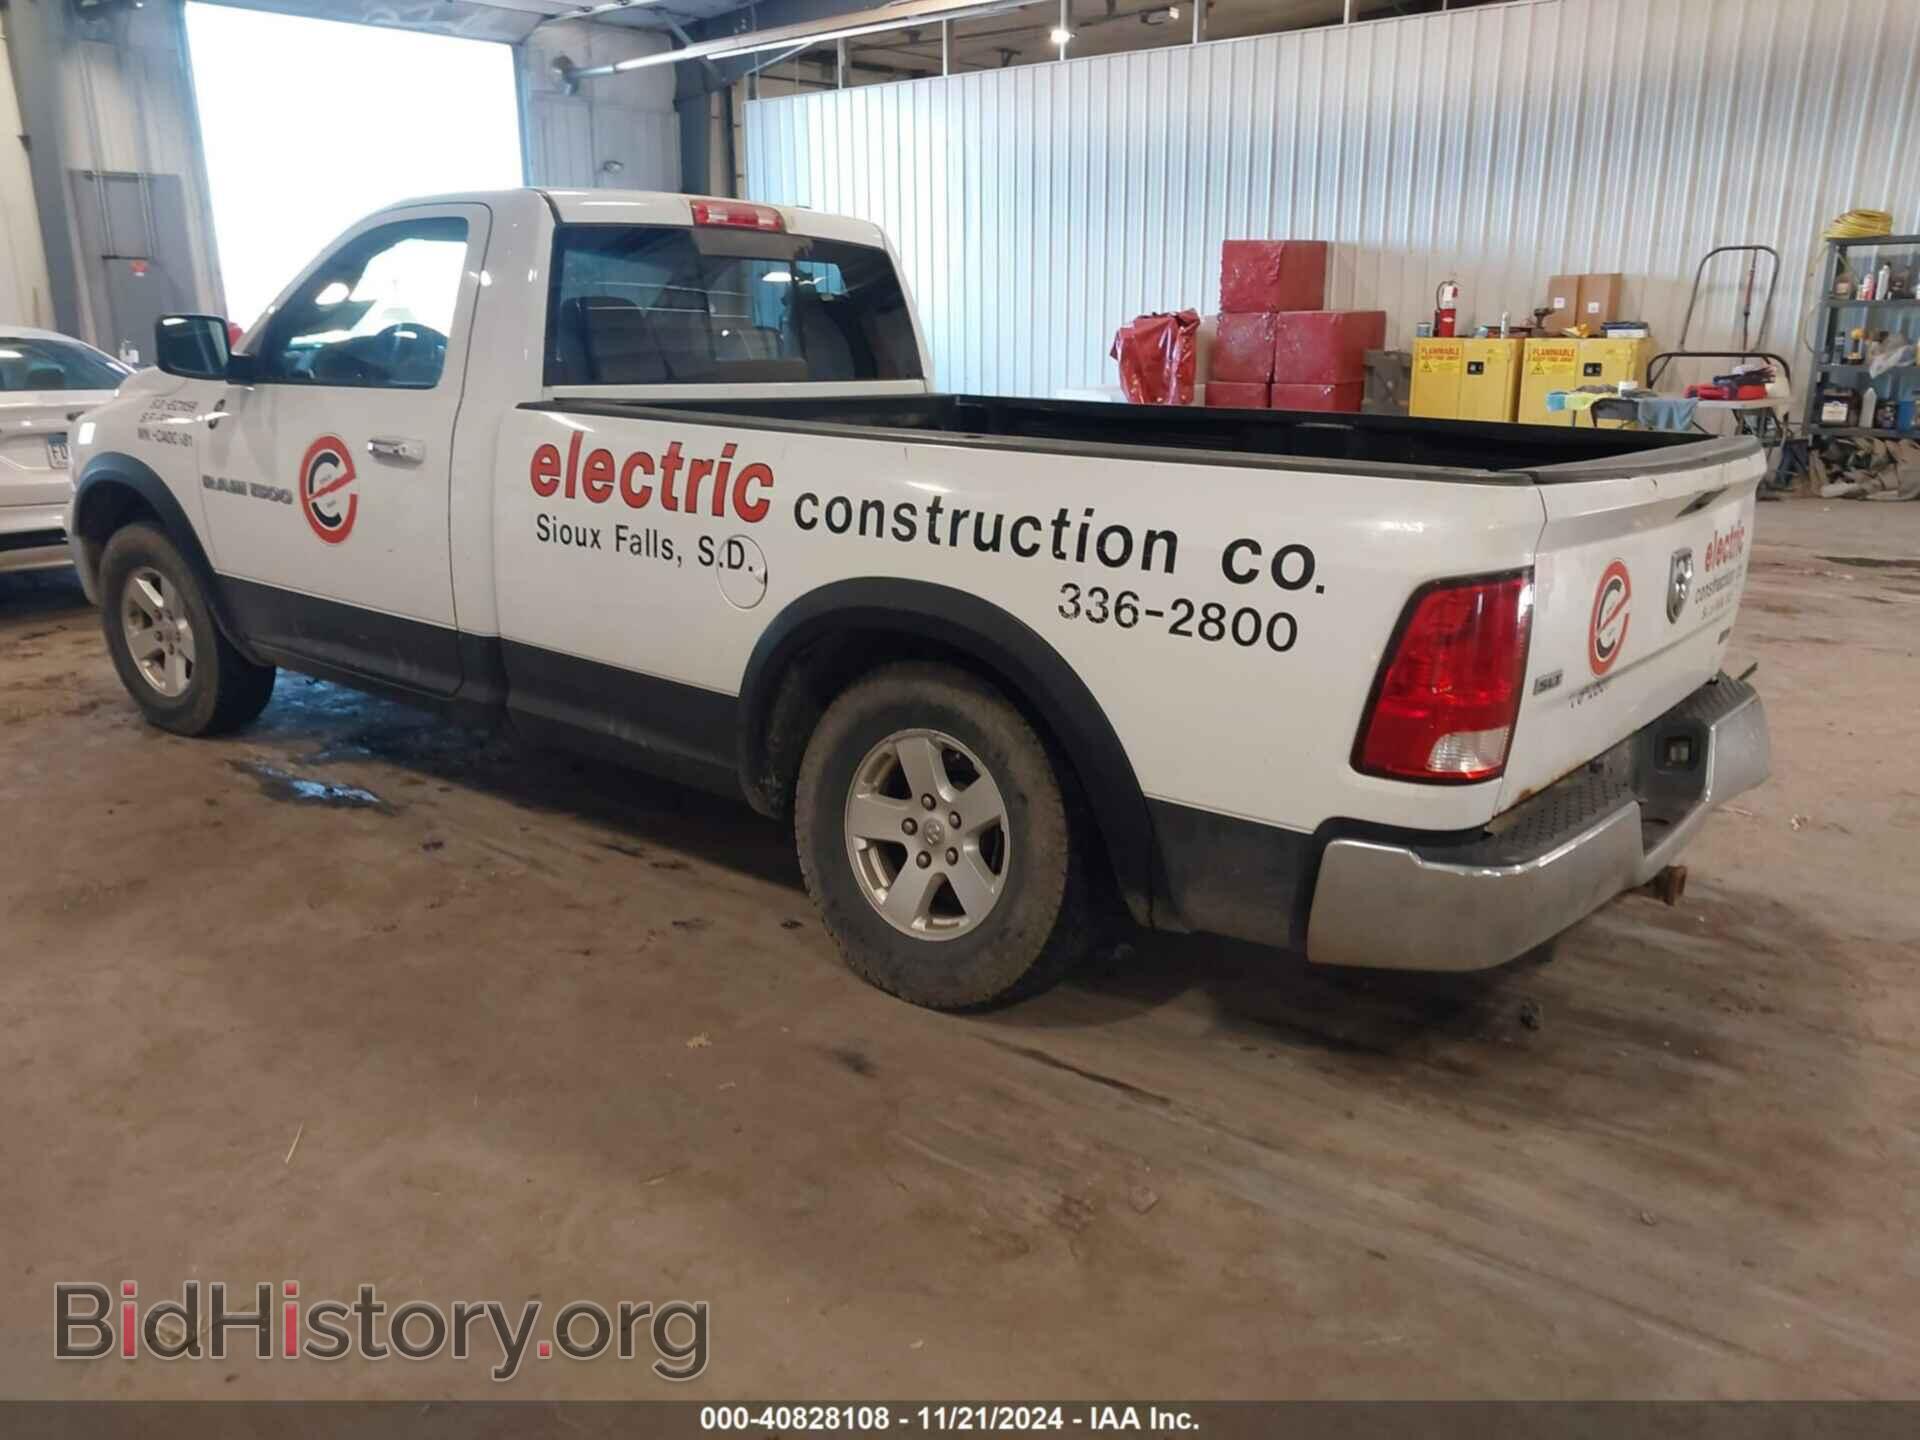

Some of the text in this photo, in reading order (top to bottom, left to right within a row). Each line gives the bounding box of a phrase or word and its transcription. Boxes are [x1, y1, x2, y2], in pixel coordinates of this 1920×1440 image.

[1532, 347, 1576, 357] FLAMMABLE
[530, 430, 1326, 594] electric construction co.
[536, 513, 753, 572] Sioux Falls, S.D.
[1057, 582, 1299, 653] 336-2800
